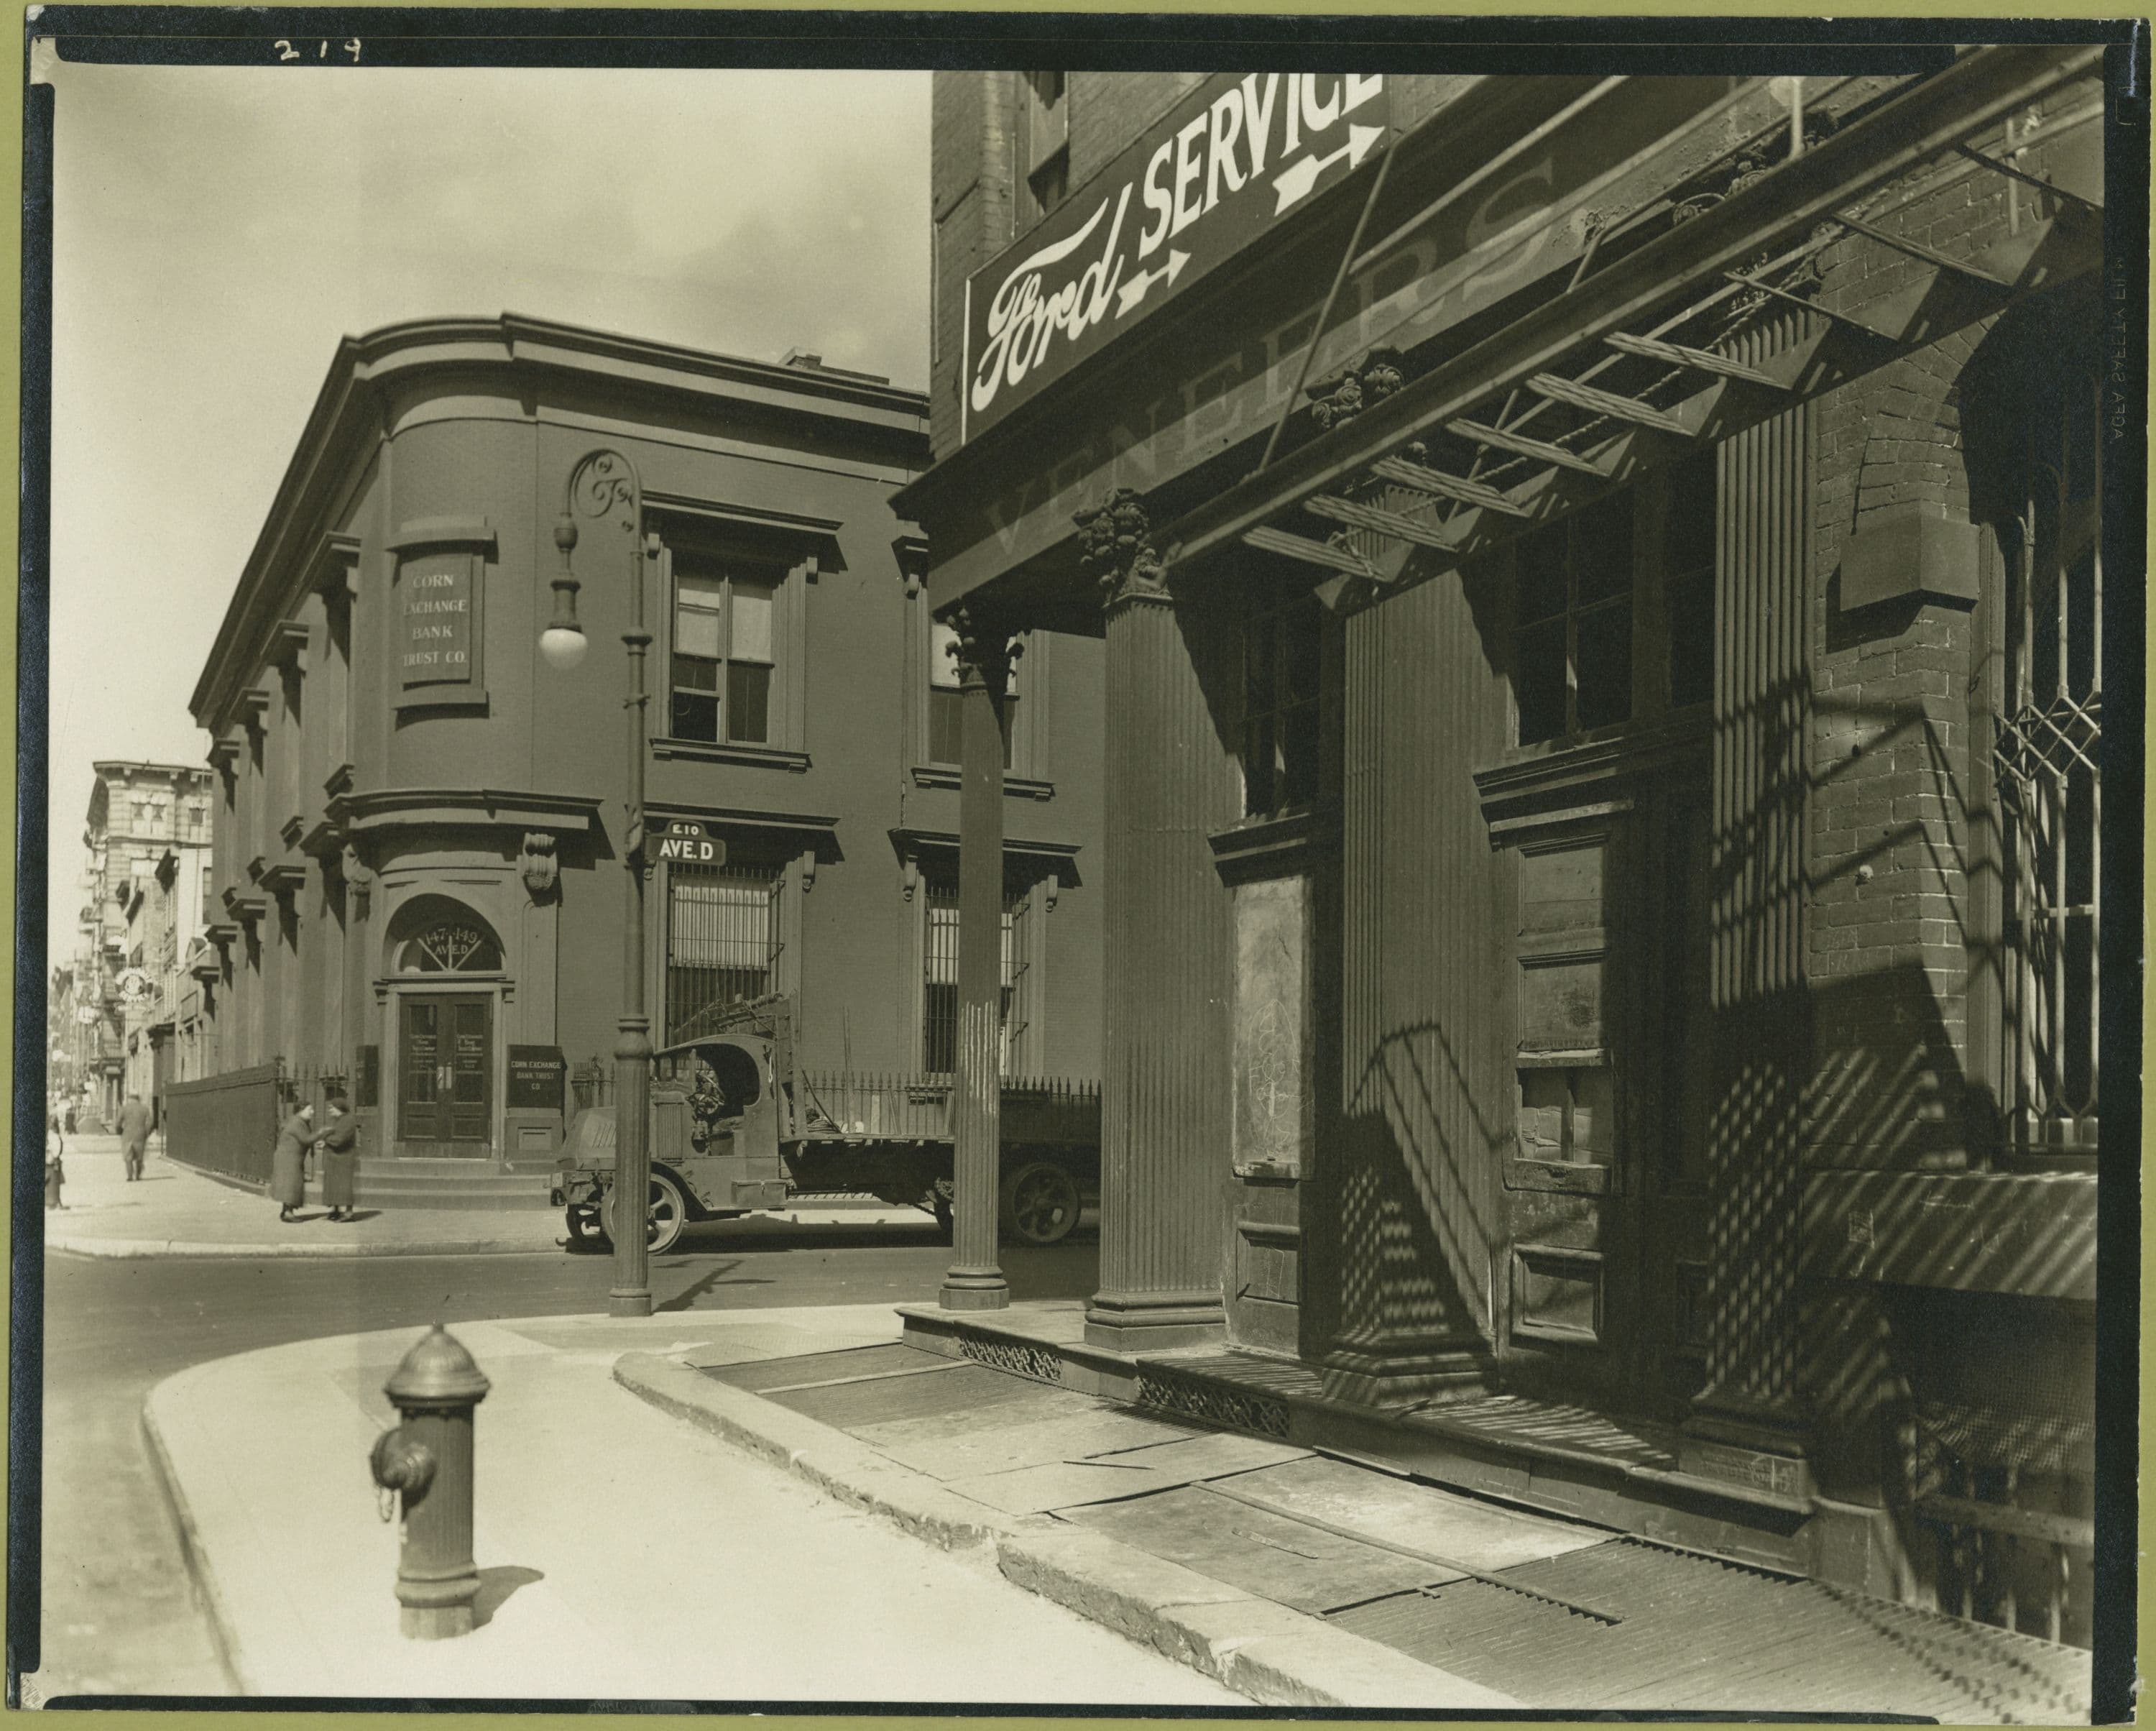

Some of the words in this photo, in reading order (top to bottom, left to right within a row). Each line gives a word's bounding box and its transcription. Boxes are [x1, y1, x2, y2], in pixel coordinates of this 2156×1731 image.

[971, 181, 1134, 413] Ford
[413, 574, 455, 588] CORN
[402, 598, 468, 616] EXCHANGE
[412, 624, 454, 640] BANK
[402, 651, 440, 668] TRUST
[699, 841, 714, 860] D
[528, 1060, 562, 1070] EXCHANGE
